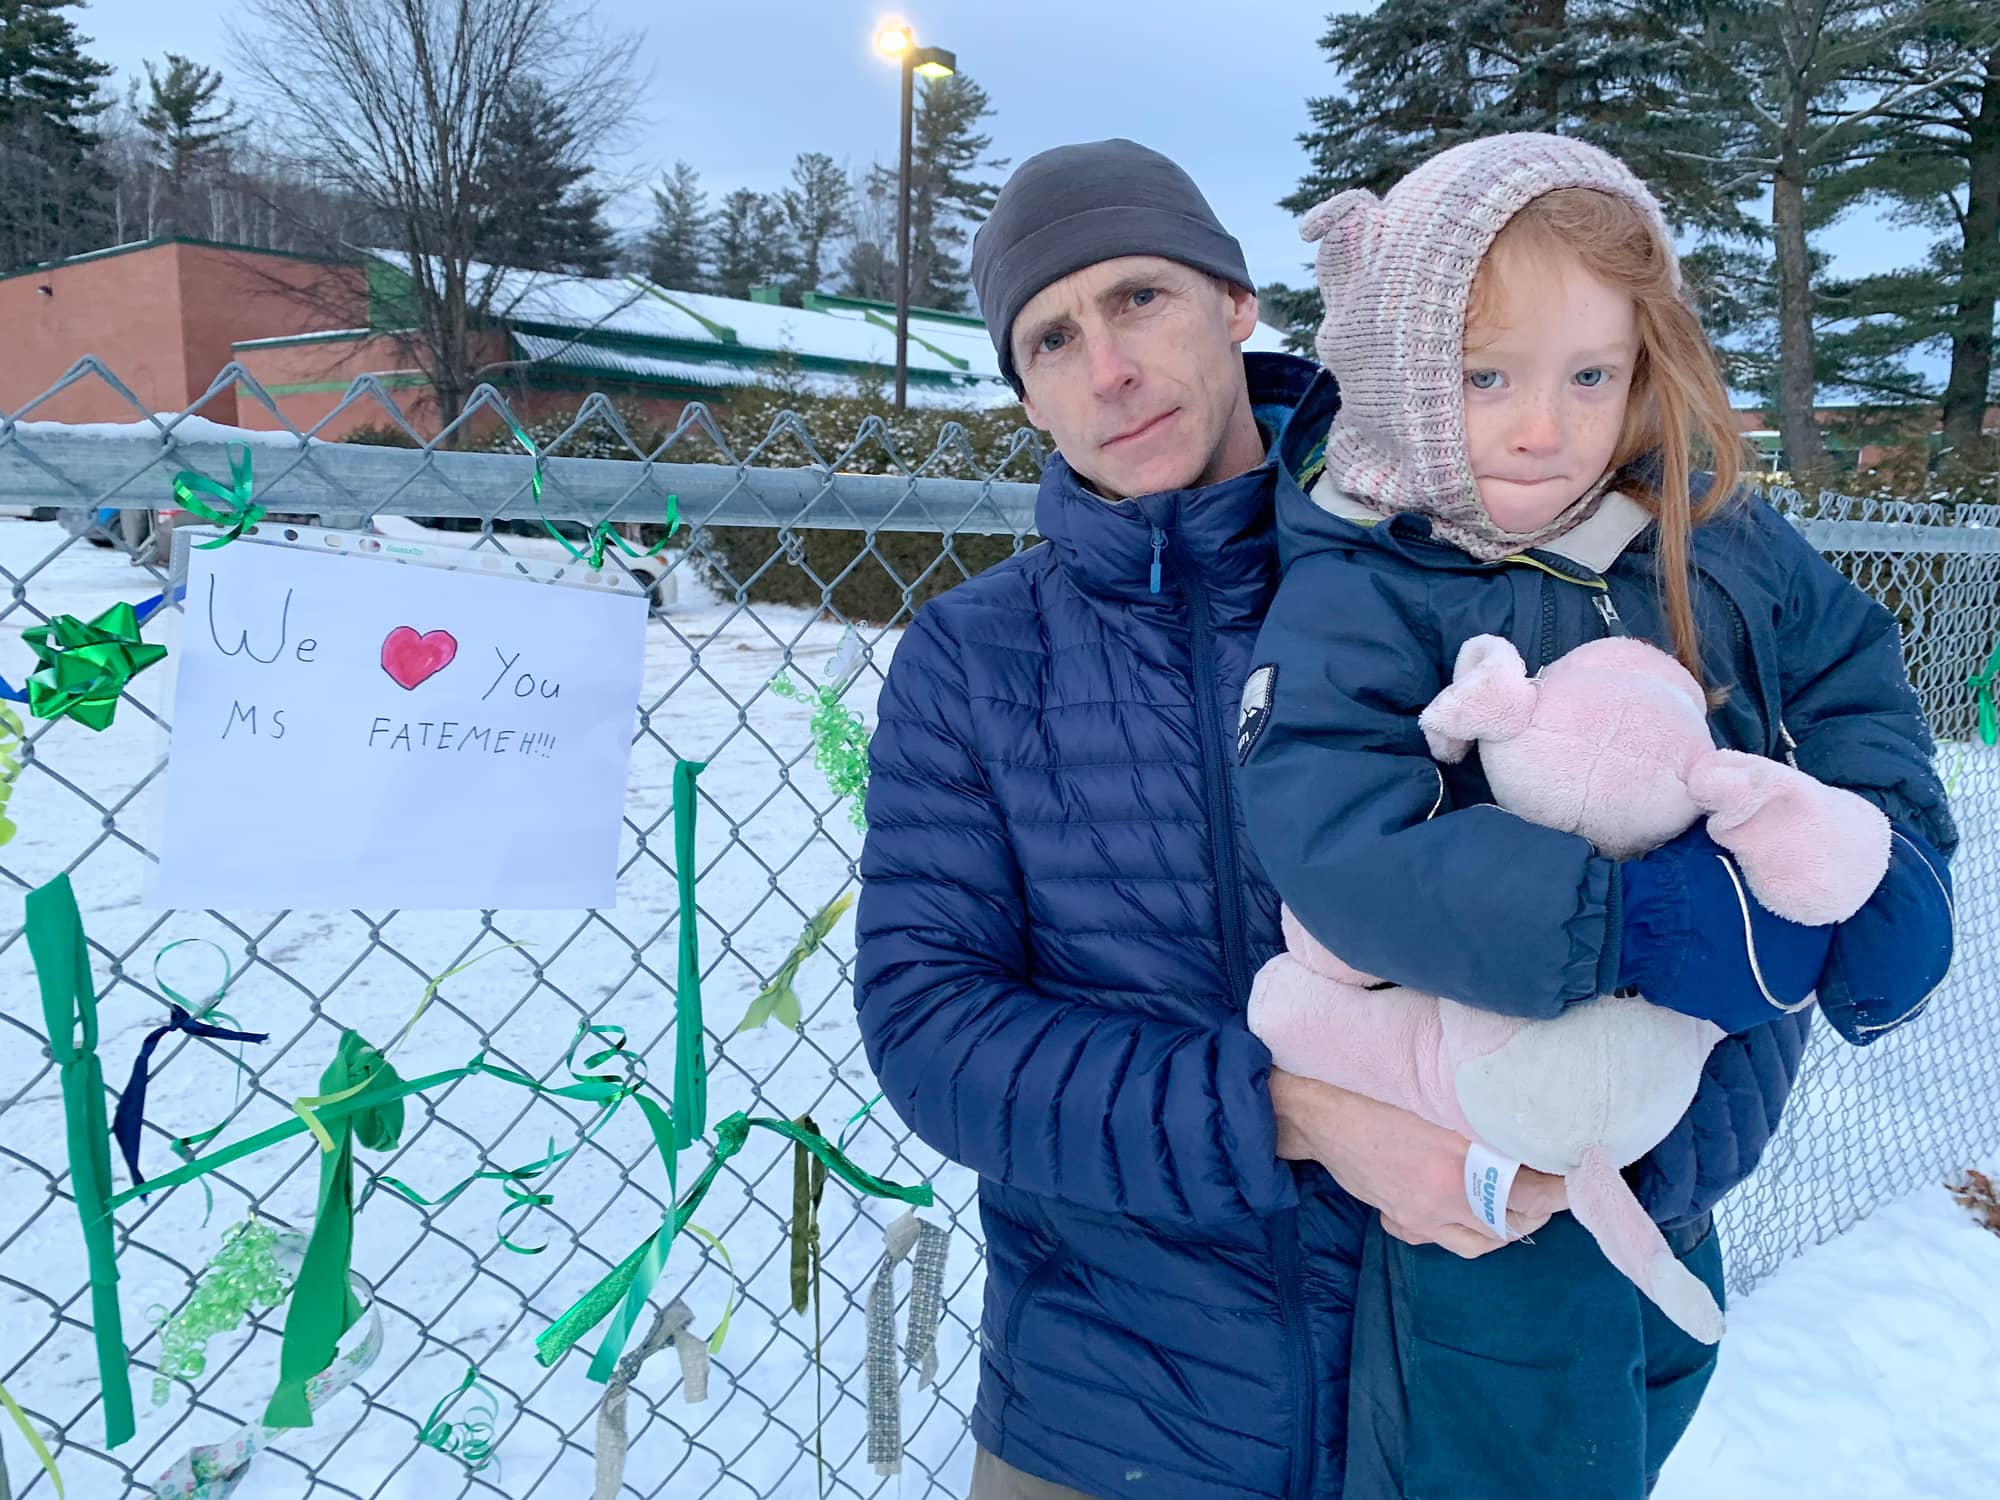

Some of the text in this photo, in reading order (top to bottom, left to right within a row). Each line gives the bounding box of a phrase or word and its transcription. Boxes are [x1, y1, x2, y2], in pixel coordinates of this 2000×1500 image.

[209, 572, 561, 701] We You
[221, 699, 557, 760] MS FATEMEH!!!
